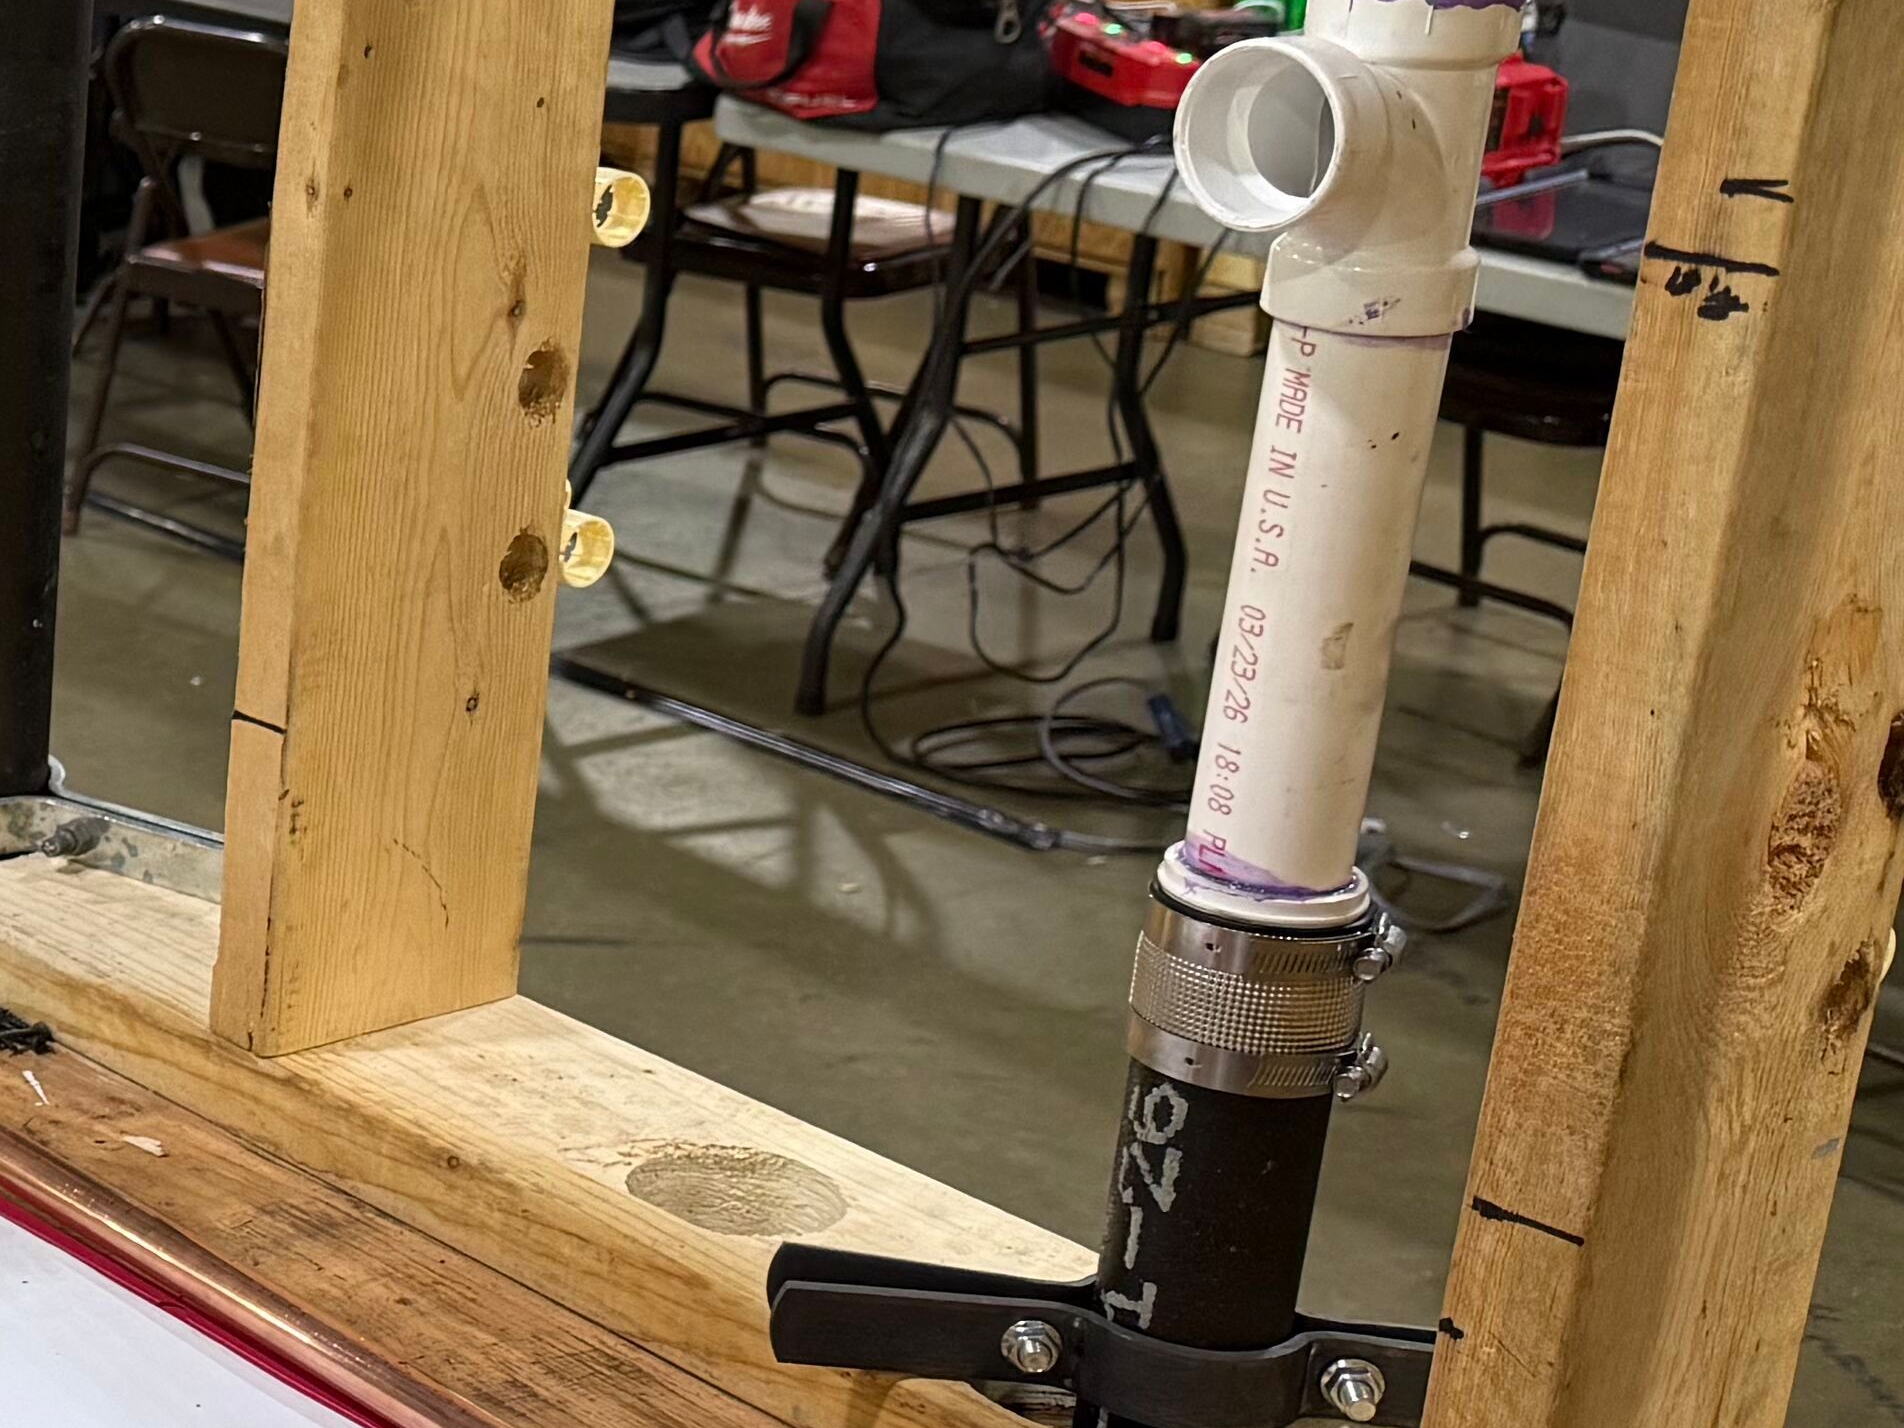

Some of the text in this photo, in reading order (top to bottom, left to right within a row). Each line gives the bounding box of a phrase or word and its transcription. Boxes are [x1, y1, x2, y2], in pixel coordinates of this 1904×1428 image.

[1274, 368, 1313, 434] MADE
[1269, 447, 1296, 490] IN
[1249, 489, 1289, 575] U.S.A.
[1223, 604, 1267, 724] 03/23/26
[1207, 744, 1241, 817] 18:08
